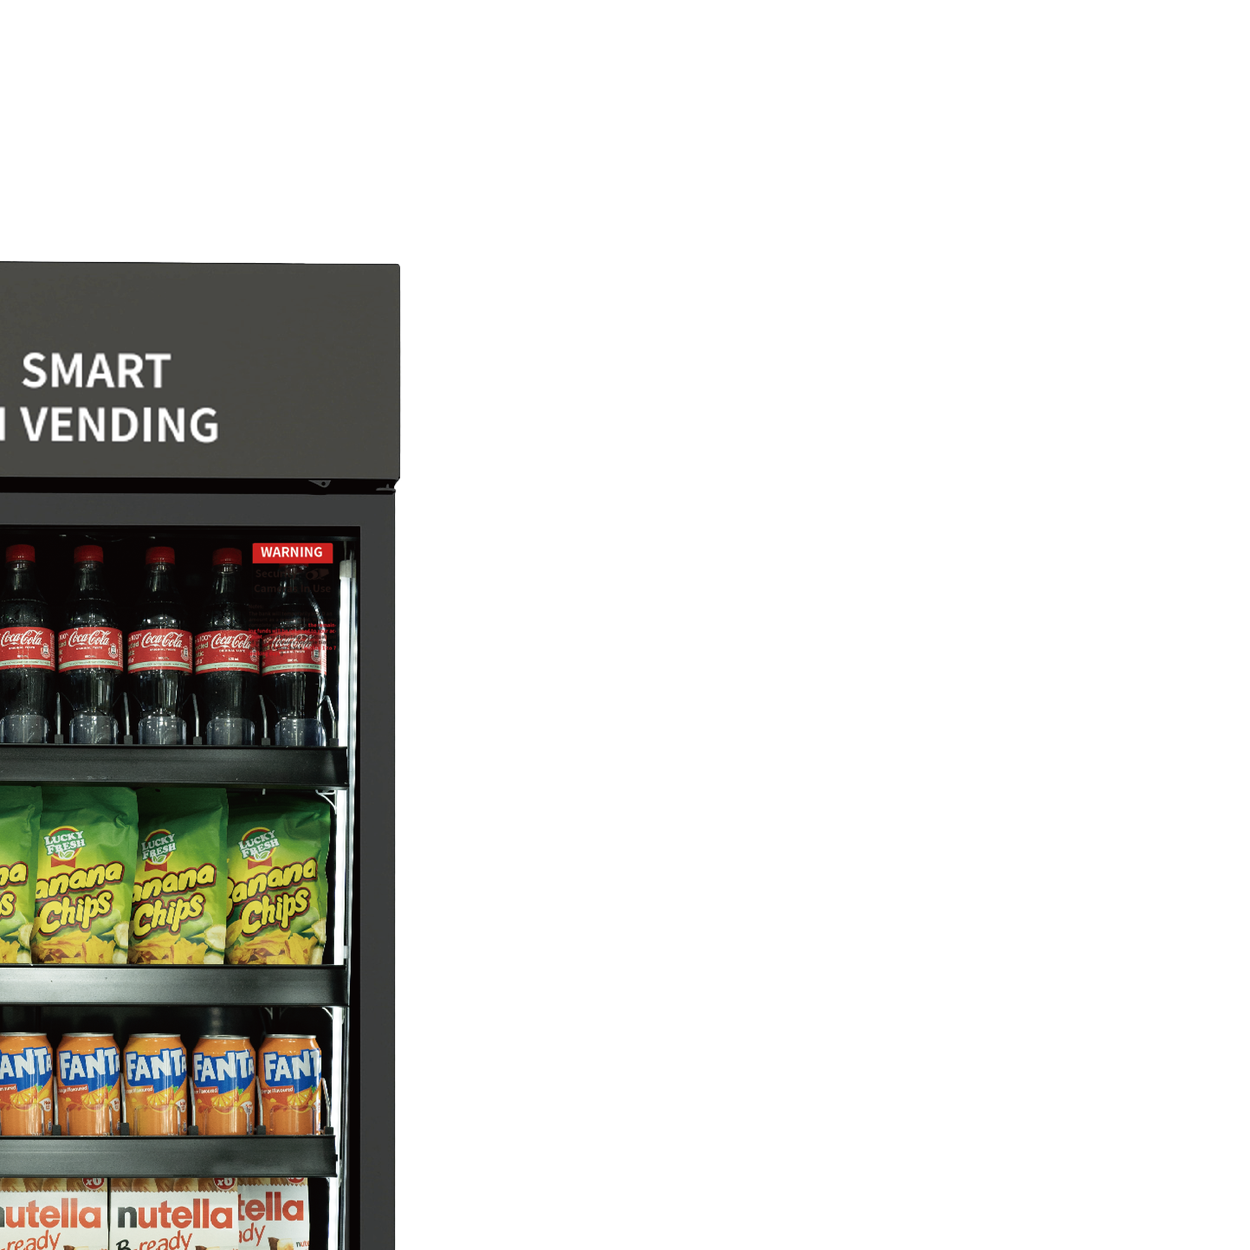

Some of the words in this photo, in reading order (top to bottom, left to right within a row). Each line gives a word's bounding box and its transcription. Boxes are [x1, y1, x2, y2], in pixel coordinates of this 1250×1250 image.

[22, 352, 171, 388] SMART
[20, 407, 218, 443] VENDING
[260, 546, 323, 558] WARNING
[255, 569, 297, 579] Security
[254, 584, 297, 593] Cameras
[313, 584, 331, 593] Use
[1, 629, 44, 647] Coca-Cola
[68, 629, 111, 647] Coca-Cola
[141, 631, 184, 648] Coca-Cola
[44, 831, 83, 846] LUCKY
[46, 839, 86, 856] FRESH
[141, 834, 175, 850] LUCKY
[239, 831, 276, 849] LUCKY
[142, 843, 177, 860] FRESH
[241, 840, 279, 859] FRESH
[38, 891, 112, 935] Chips
[134, 894, 205, 938] Chips
[240, 888, 310, 935] Chips
[117, 1198, 233, 1229] nutella
